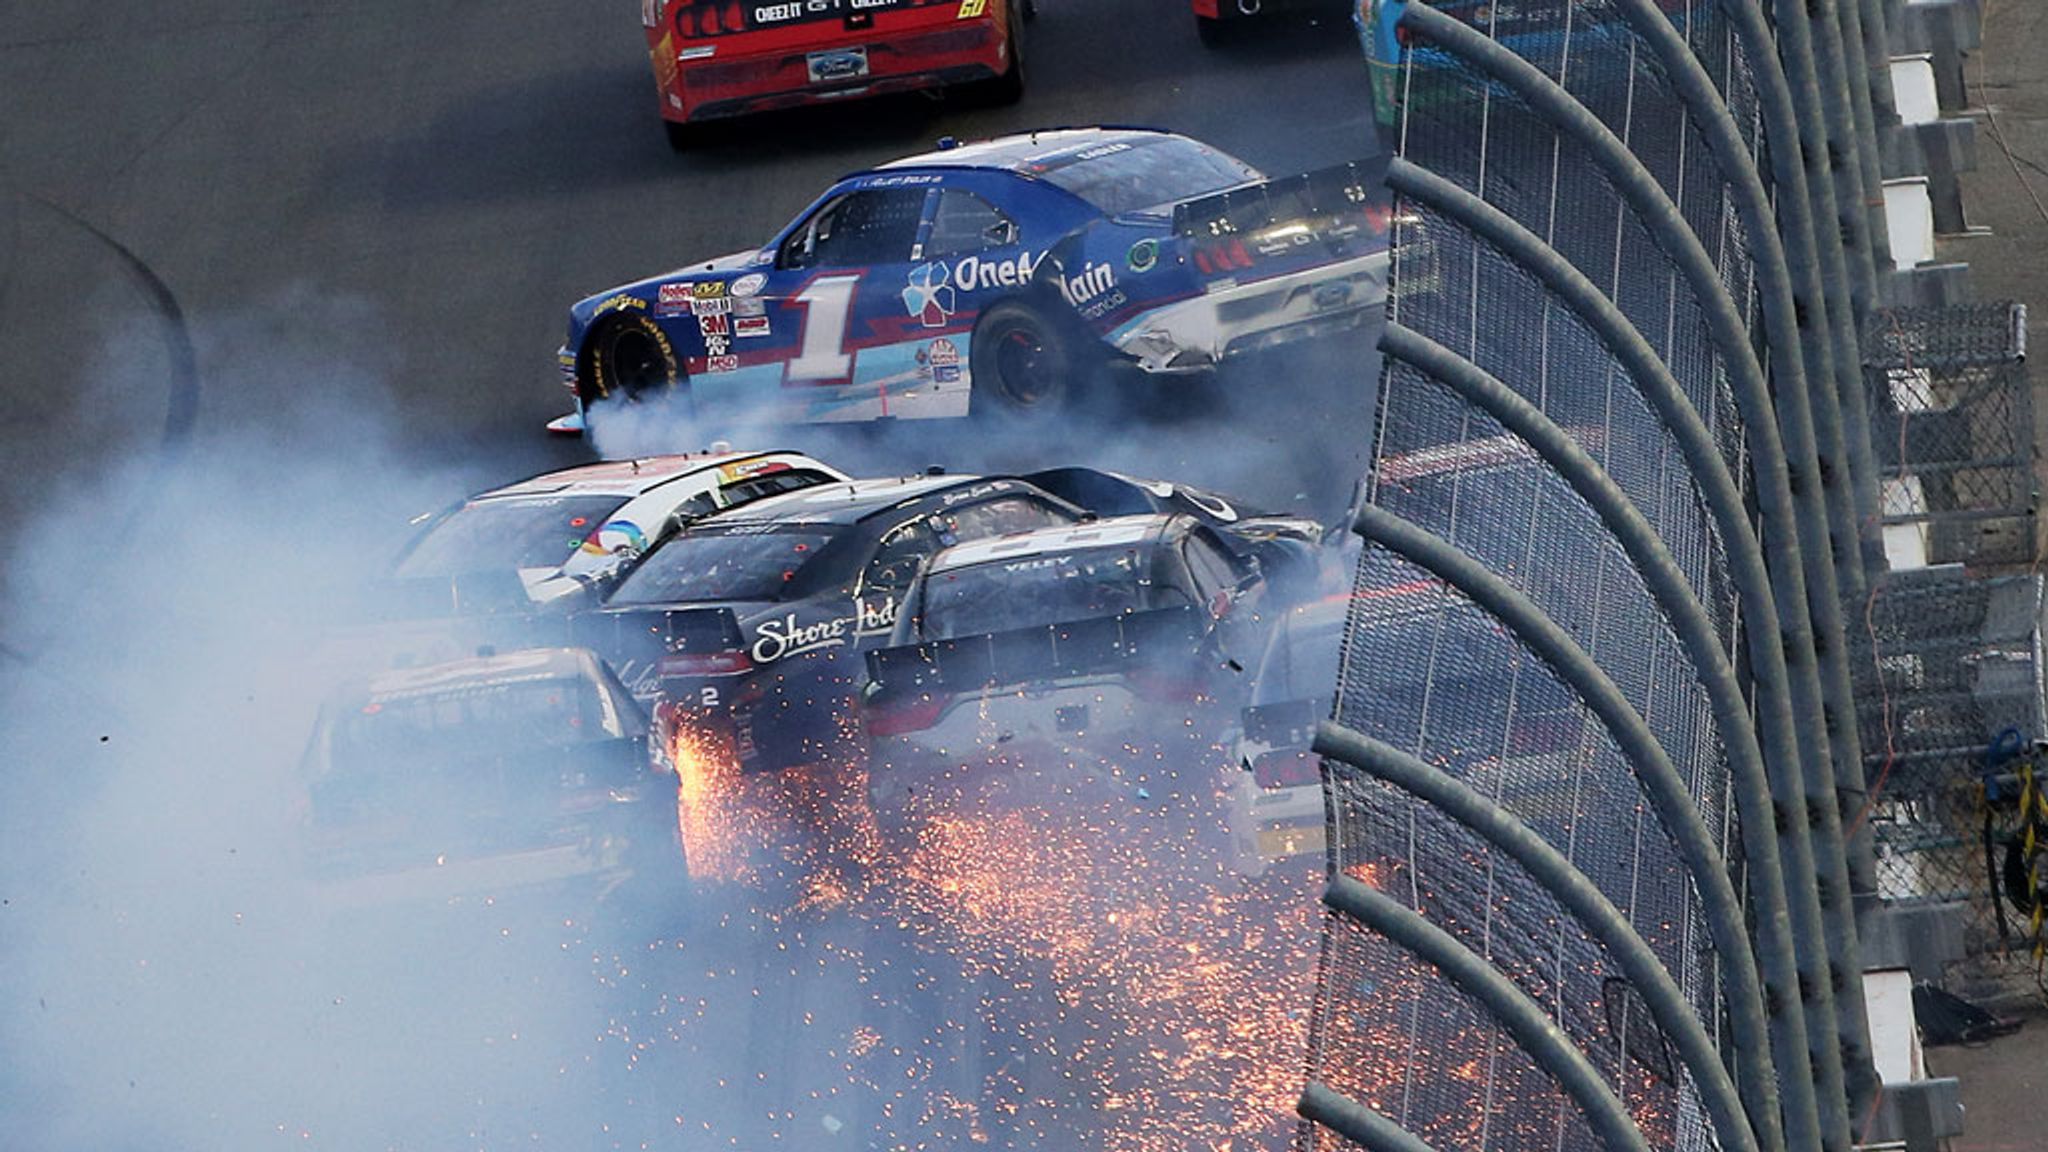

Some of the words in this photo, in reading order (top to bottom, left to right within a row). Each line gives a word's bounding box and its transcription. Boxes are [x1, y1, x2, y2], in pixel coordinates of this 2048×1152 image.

[702, 315, 728, 334] 3M
[785, 272, 863, 383] 1
[701, 687, 719, 705] 2
